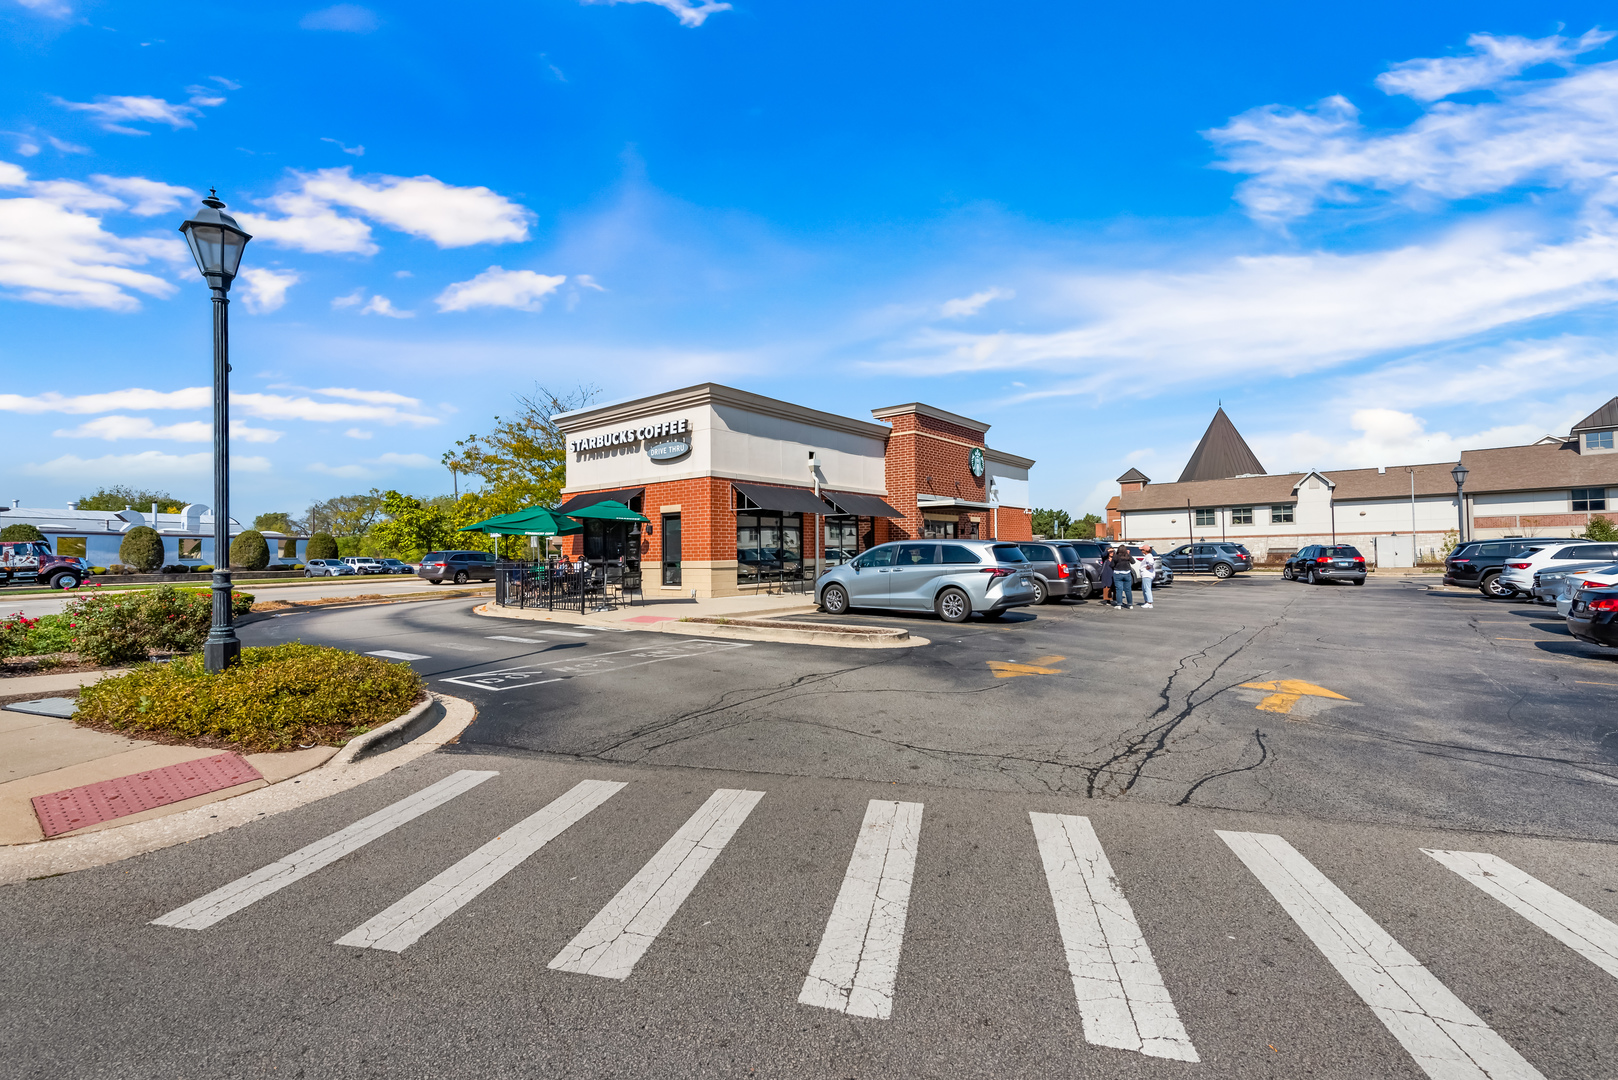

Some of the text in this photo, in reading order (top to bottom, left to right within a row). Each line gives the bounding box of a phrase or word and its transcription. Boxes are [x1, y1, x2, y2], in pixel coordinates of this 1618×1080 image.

[569, 419, 688, 452] STARBUCKS COFFEE
[650, 444, 685, 456] DRIVE THRU
